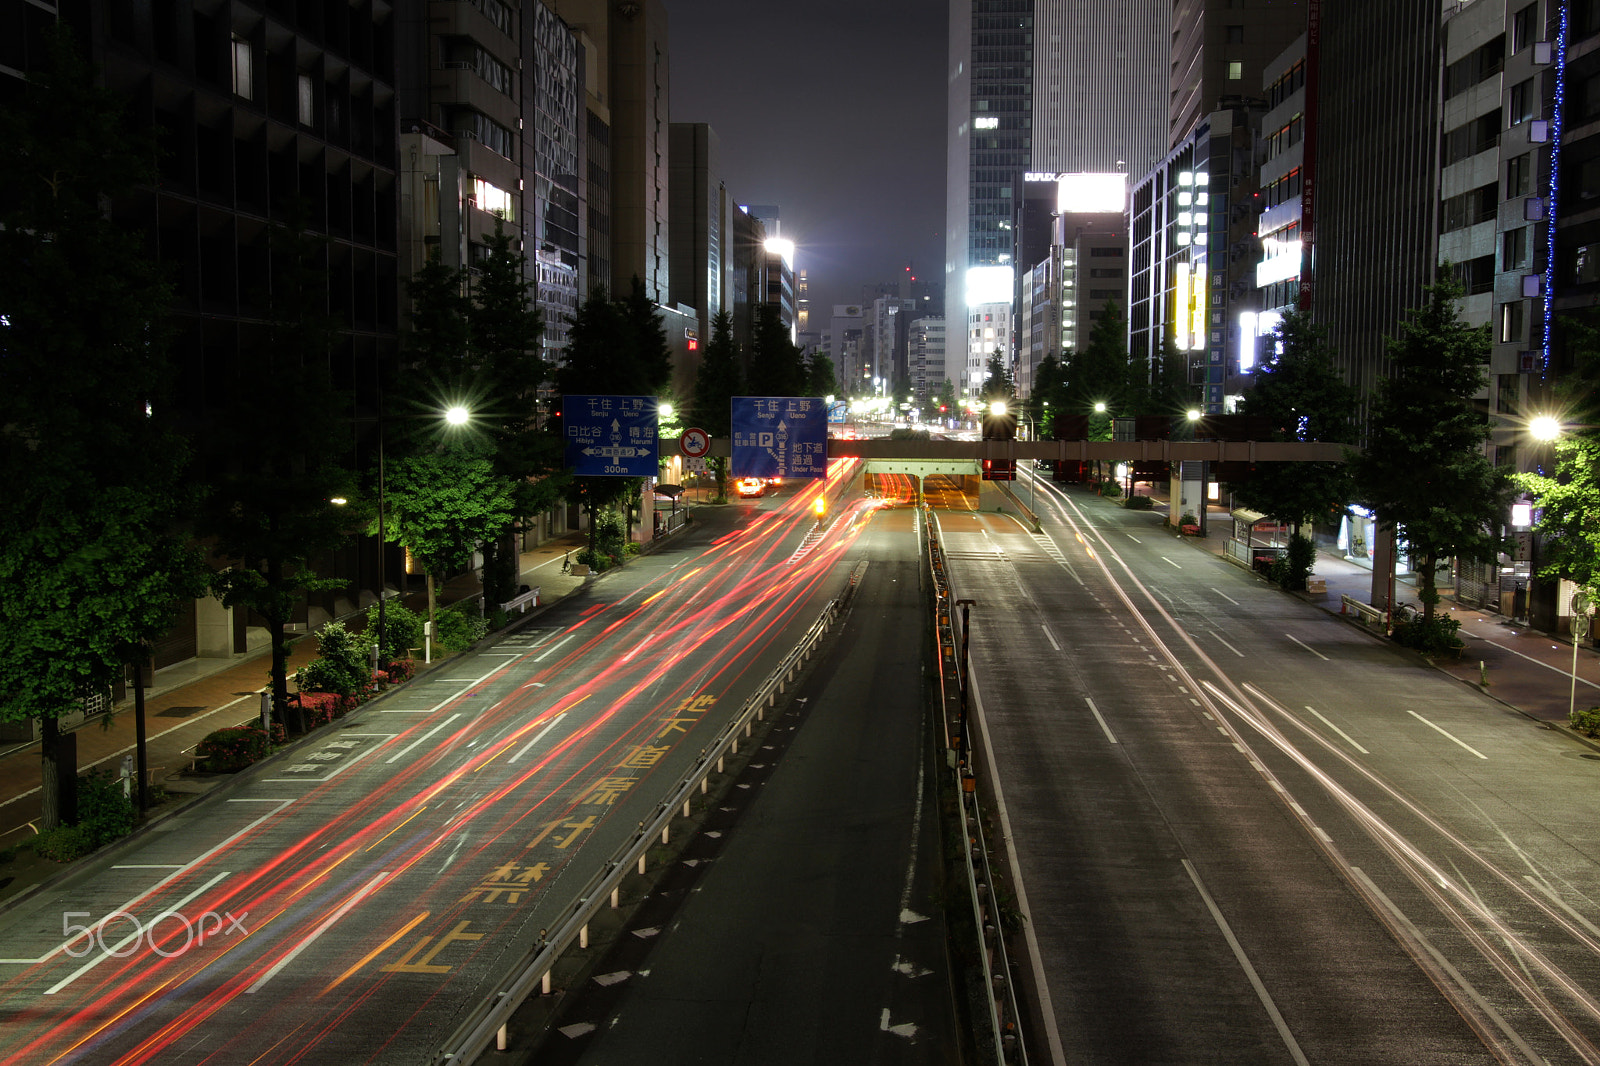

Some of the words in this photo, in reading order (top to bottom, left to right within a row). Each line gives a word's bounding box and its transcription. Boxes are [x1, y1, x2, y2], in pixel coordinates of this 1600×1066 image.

[1024, 172, 1057, 182] DUPLEX
[1305, 179, 1313, 214] 株式会社
[1211, 275, 1222, 361] 須山補聴器
[587, 398, 612, 410] 千住
[619, 398, 644, 410] 上野
[753, 400, 779, 412] 千住
[785, 400, 811, 412] 上野
[591, 410, 609, 418] Senju
[568, 425, 602, 437] 日比谷
[629, 427, 654, 438] 晴海
[792, 442, 824, 454] 地下道
[792, 454, 813, 465] 通過
[604, 465, 629, 473] 300m
